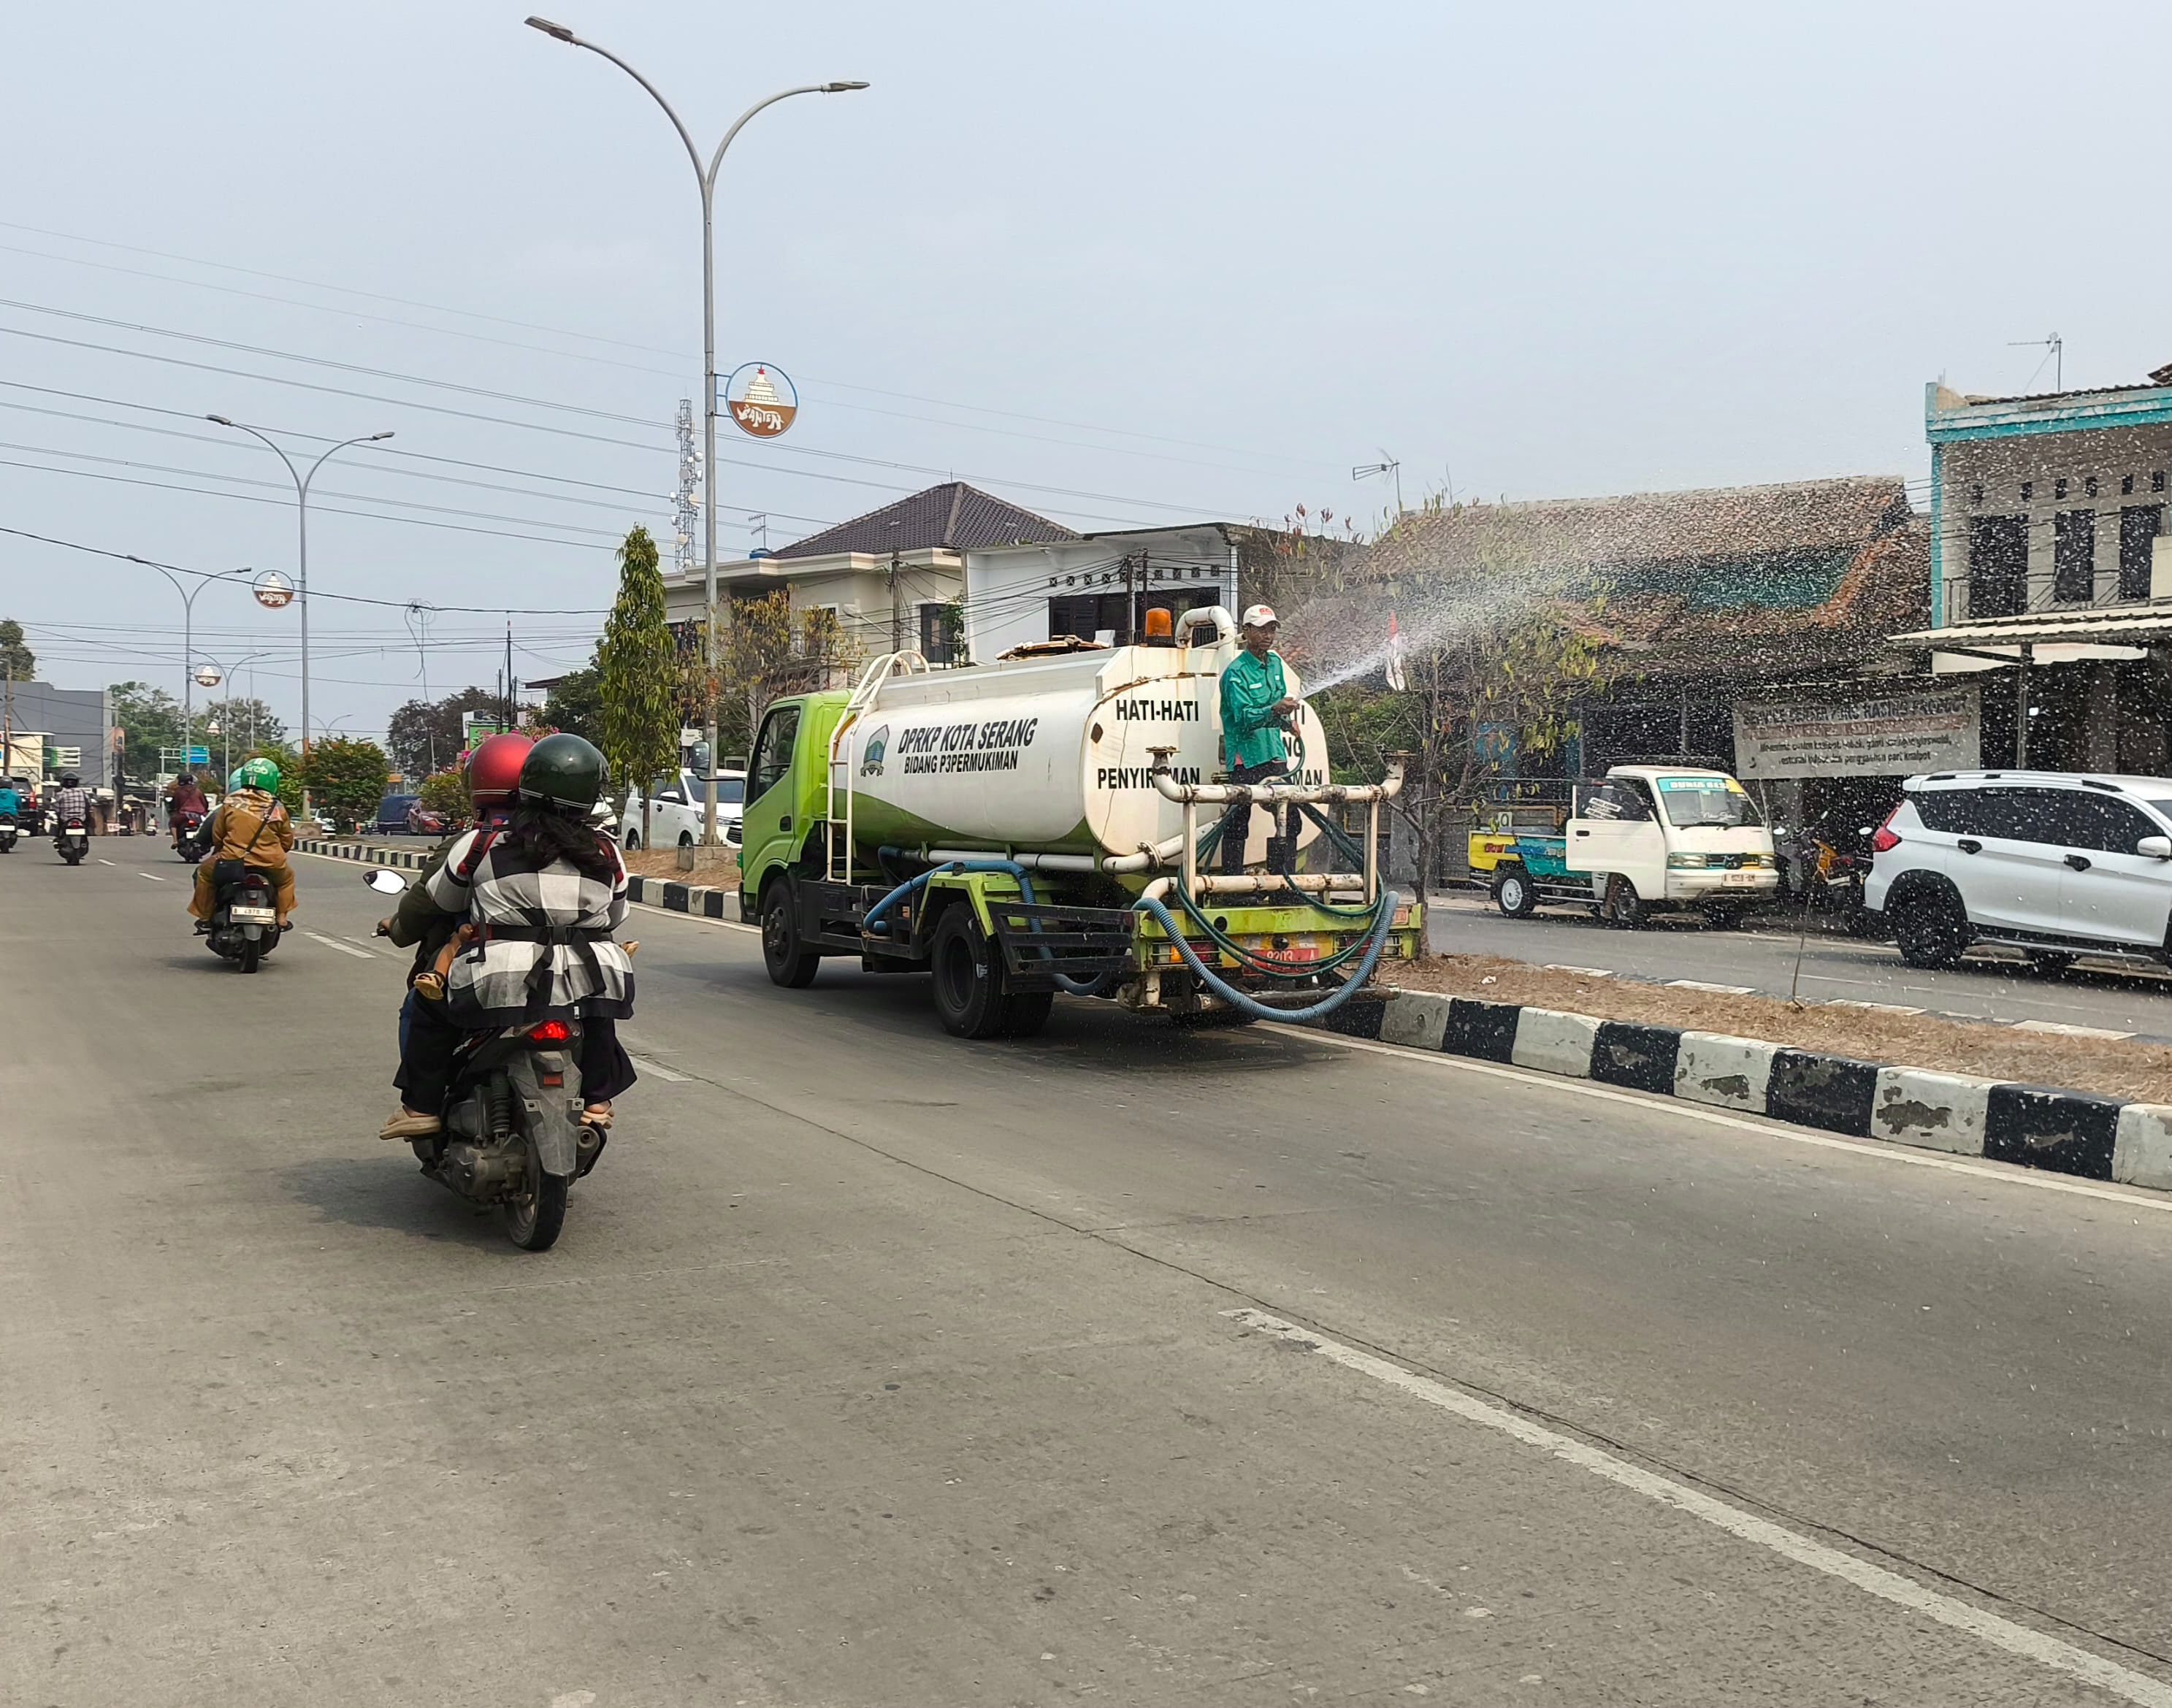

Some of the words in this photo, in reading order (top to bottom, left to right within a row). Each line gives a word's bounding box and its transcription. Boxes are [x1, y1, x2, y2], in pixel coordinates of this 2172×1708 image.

[736, 403, 784, 430] BANTEN
[1116, 699, 1199, 721] HATI-HATI
[898, 727, 943, 754] DPRKP
[939, 723, 976, 752] KOTA
[978, 718, 1039, 749] SERANG
[244, 765, 269, 775] Grab
[904, 753, 938, 774] BIDANG
[939, 749, 1019, 773] P3PERMUKIMAN
[1098, 767, 1201, 789] PENYIRMAN
